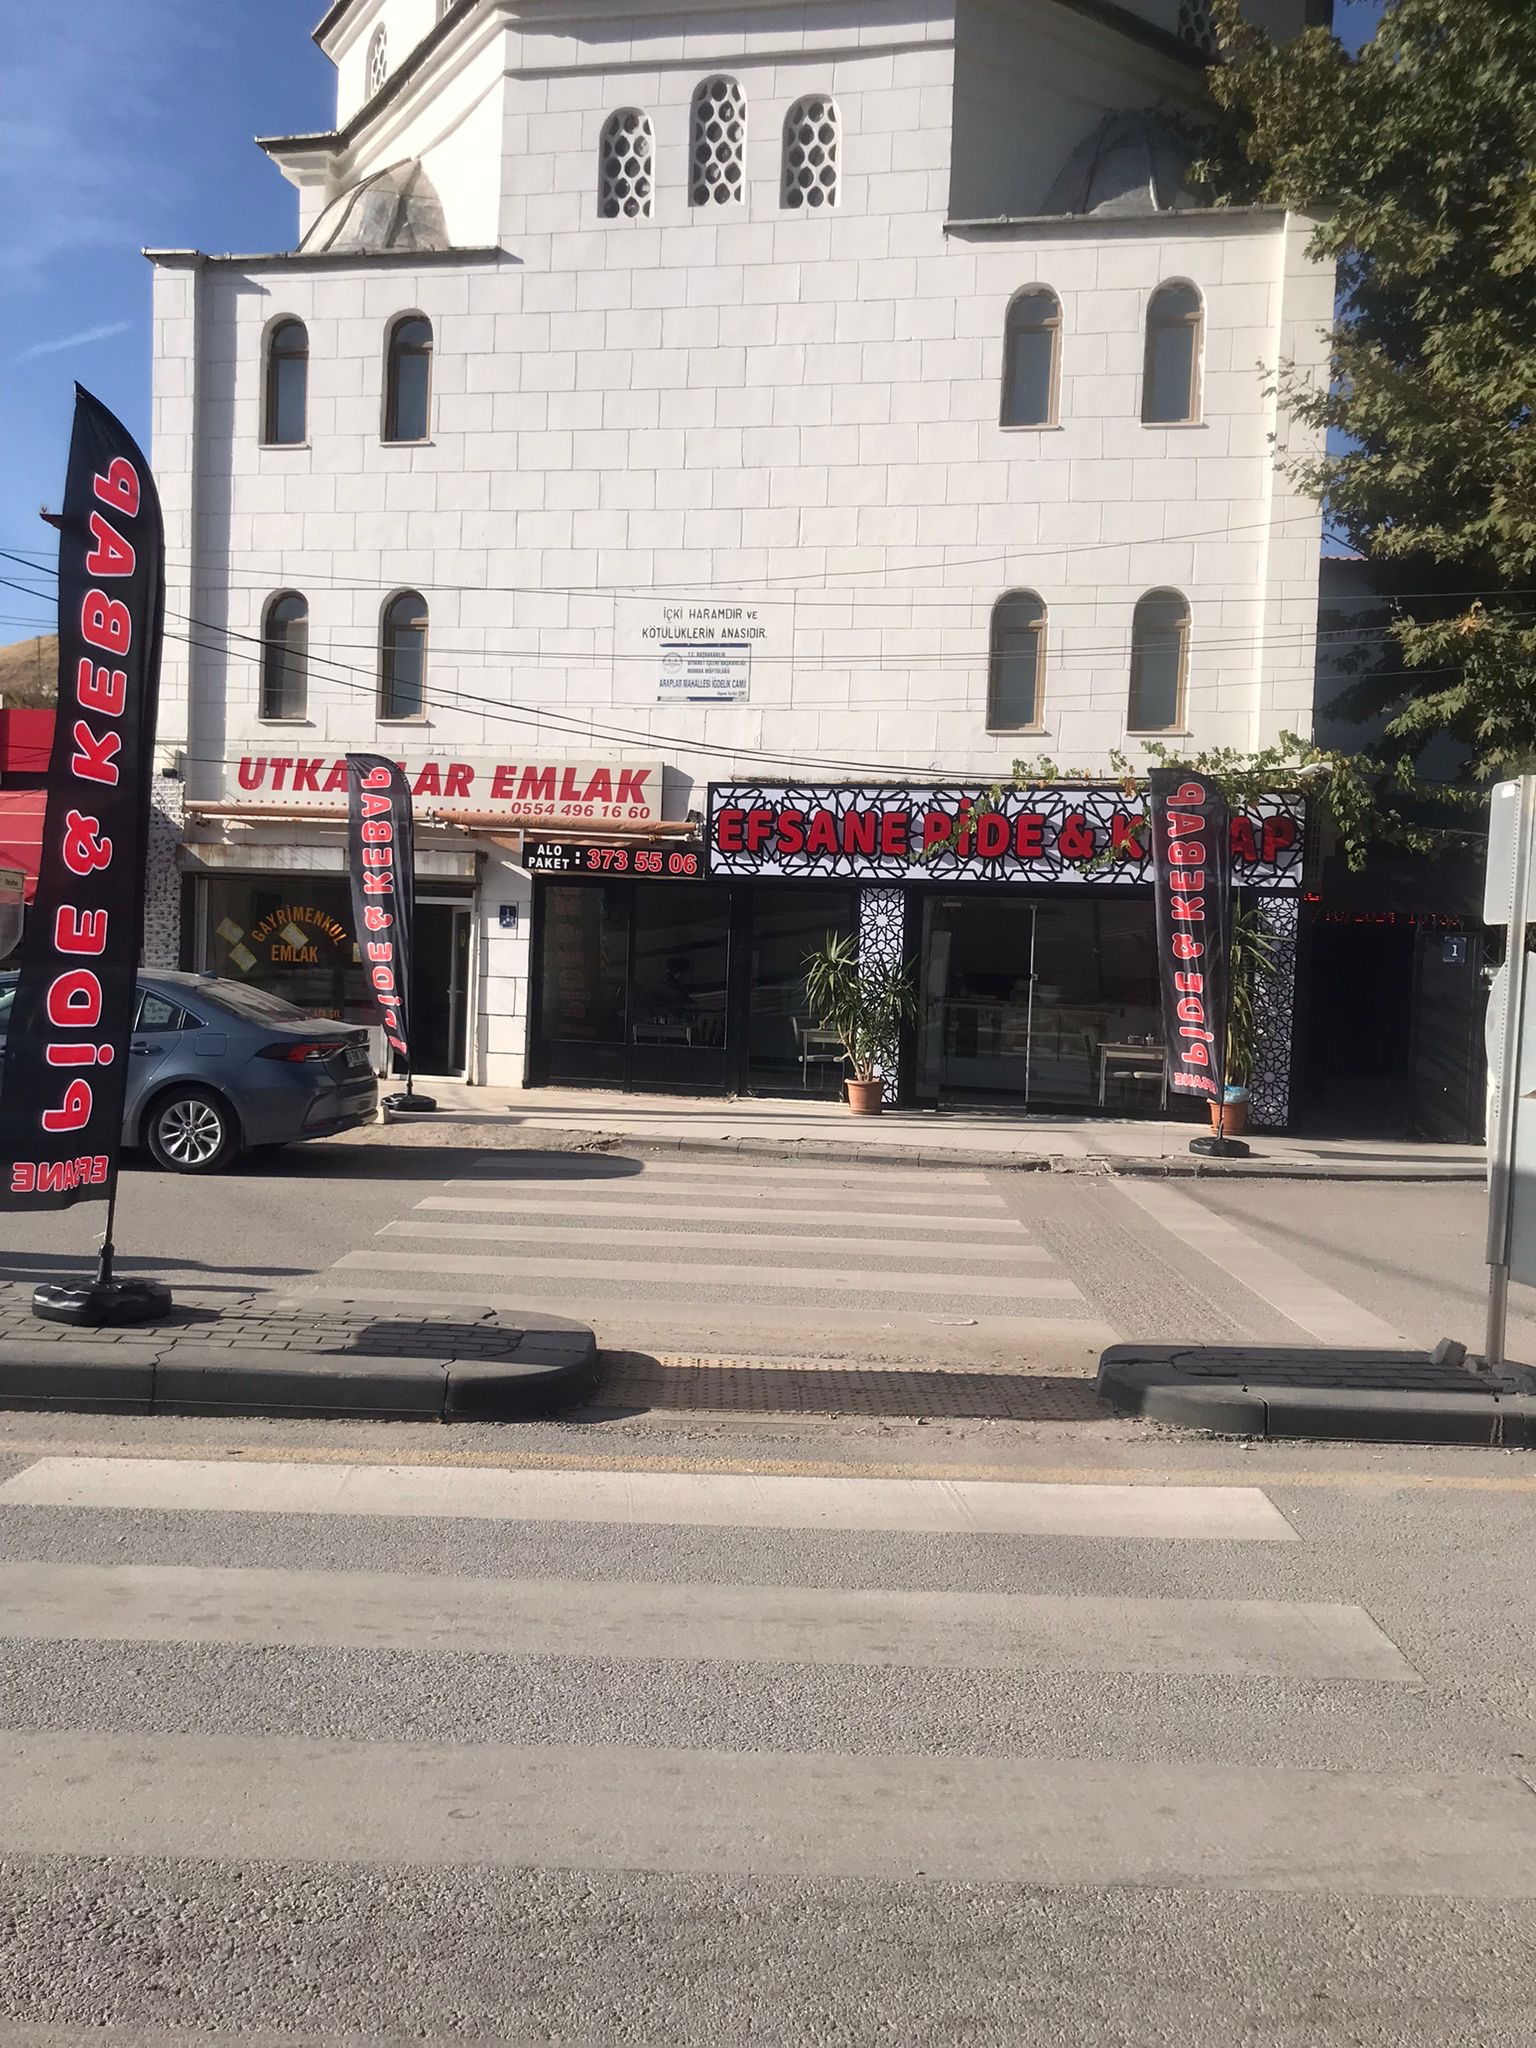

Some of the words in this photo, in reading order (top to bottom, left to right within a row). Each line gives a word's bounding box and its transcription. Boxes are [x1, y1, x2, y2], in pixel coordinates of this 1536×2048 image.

[663, 606, 683, 622] İÇKİ
[688, 608, 743, 620] HARAMDIR
[490, 765, 652, 804] EMLAK
[510, 802, 556, 816] 0554
[560, 804, 594, 817] 496
[601, 805, 622, 818] 16
[628, 806, 651, 819] 60
[716, 808, 909, 857] EFSANE
[922, 796, 1046, 860] PİDE
[1058, 812, 1094, 859] &
[1111, 813, 1297, 863] KAP
[537, 844, 562, 856] ALO
[528, 857, 570, 870] PAKET
[586, 848, 628, 871] 373
[633, 850, 662, 872] 55
[668, 853, 698, 874] 06
[251, 904, 349, 946] GAYRİMENKUL
[271, 944, 319, 963] EMLAK
